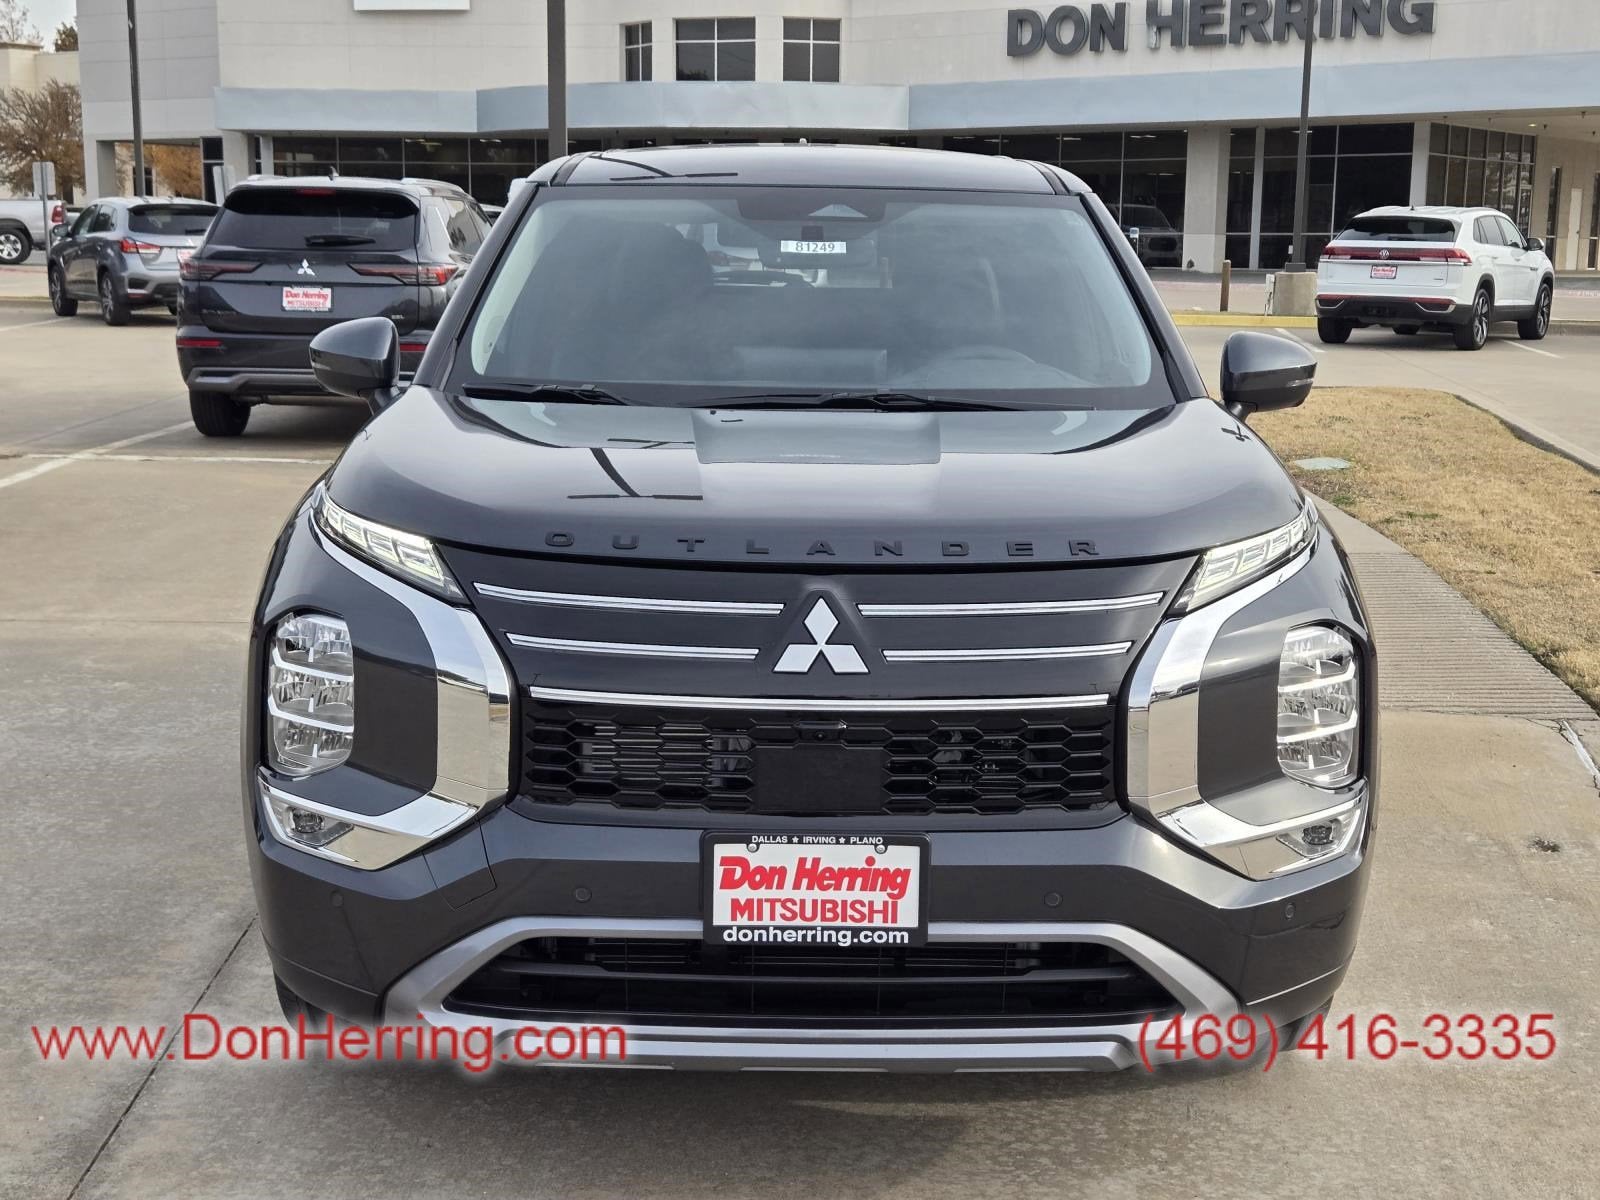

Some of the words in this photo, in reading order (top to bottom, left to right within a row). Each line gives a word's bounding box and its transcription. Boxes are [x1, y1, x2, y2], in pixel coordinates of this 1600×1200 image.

[1007, 2, 1128, 57] DON
[1146, 0, 1435, 49] HERRING
[795, 241, 835, 252] 81249
[545, 531, 1100, 557] OUTLANDER
[752, 835, 788, 844] DALLAS
[803, 836, 837, 845] IRVING
[850, 836, 884, 845] PLANO
[719, 855, 788, 891] Don
[792, 855, 912, 901] Herring
[730, 897, 898, 924] MITSUBISHI
[722, 926, 909, 947] donherring.com
